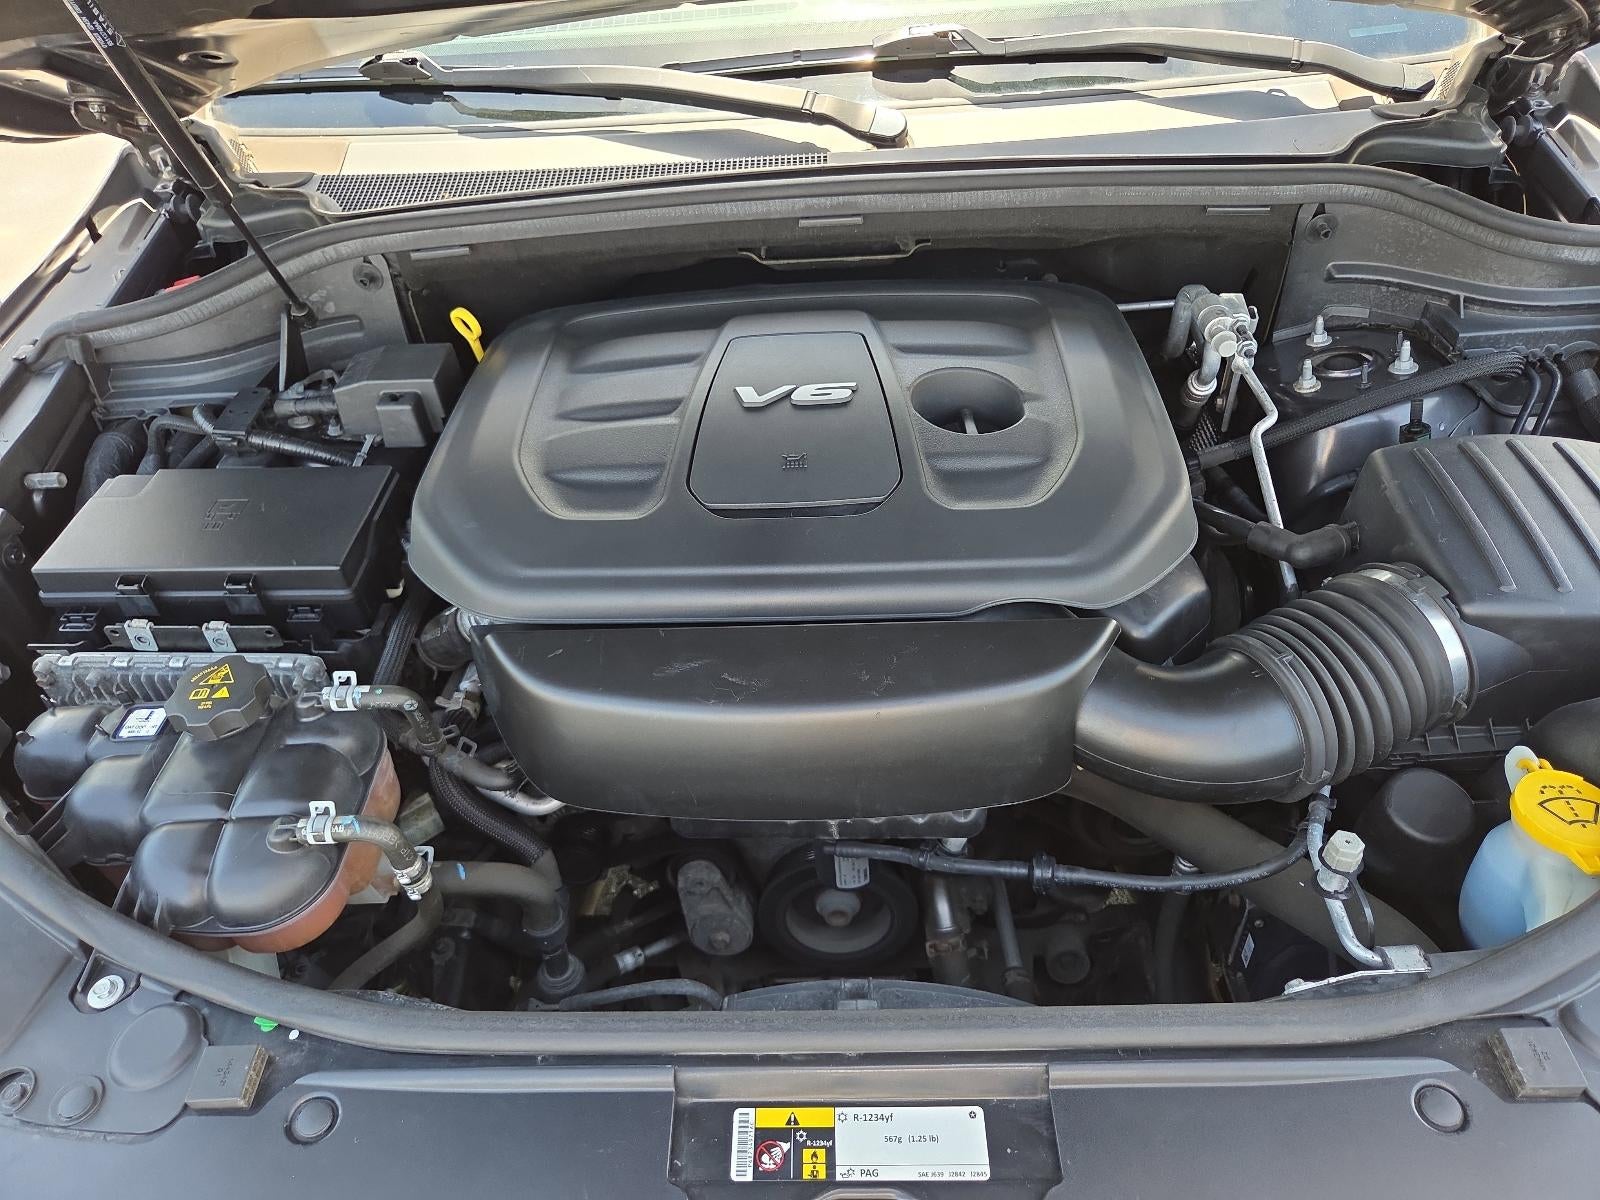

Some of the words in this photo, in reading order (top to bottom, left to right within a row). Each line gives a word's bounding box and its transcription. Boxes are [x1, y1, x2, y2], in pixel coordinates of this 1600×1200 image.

[734, 382, 859, 409] V6
[853, 1112, 894, 1124] R-1234yf
[884, 1135, 903, 1144] 567g
[908, 1134, 927, 1144] (1.25
[928, 1134, 940, 1144] lb)
[860, 1168, 879, 1179] PAG
